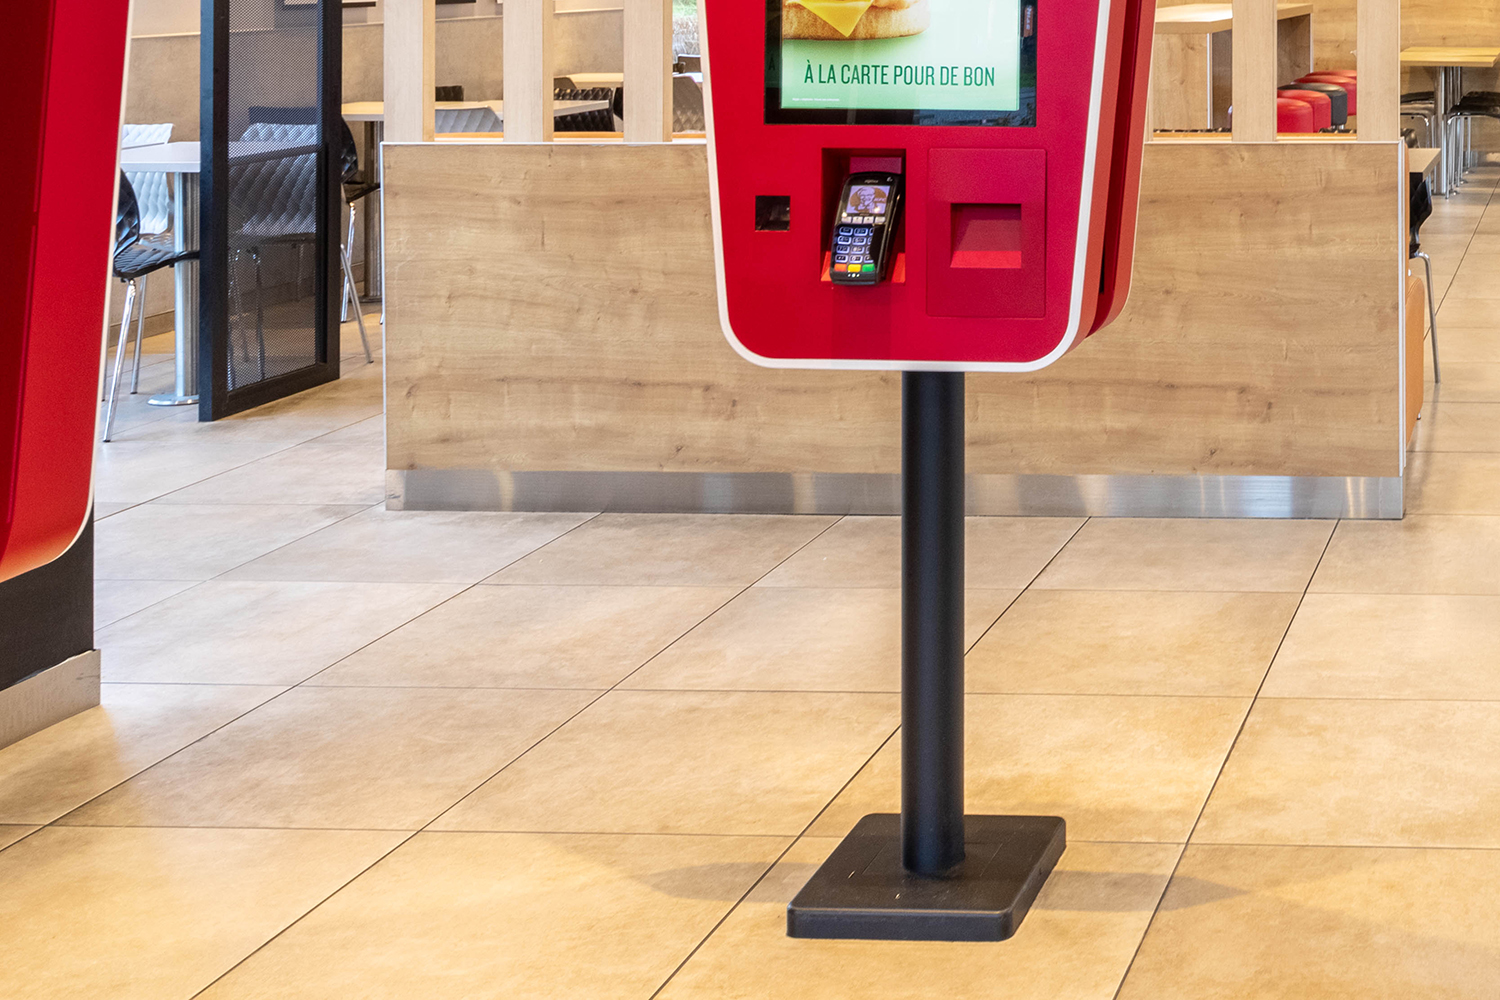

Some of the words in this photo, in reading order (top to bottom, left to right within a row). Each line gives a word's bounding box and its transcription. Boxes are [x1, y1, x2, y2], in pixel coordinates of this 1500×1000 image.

[804, 60, 813, 84] À
[818, 65, 836, 84] LA
[841, 65, 889, 85] CARTE
[894, 66, 935, 85] POUR
[940, 66, 958, 86] DE
[964, 67, 995, 86] BON
